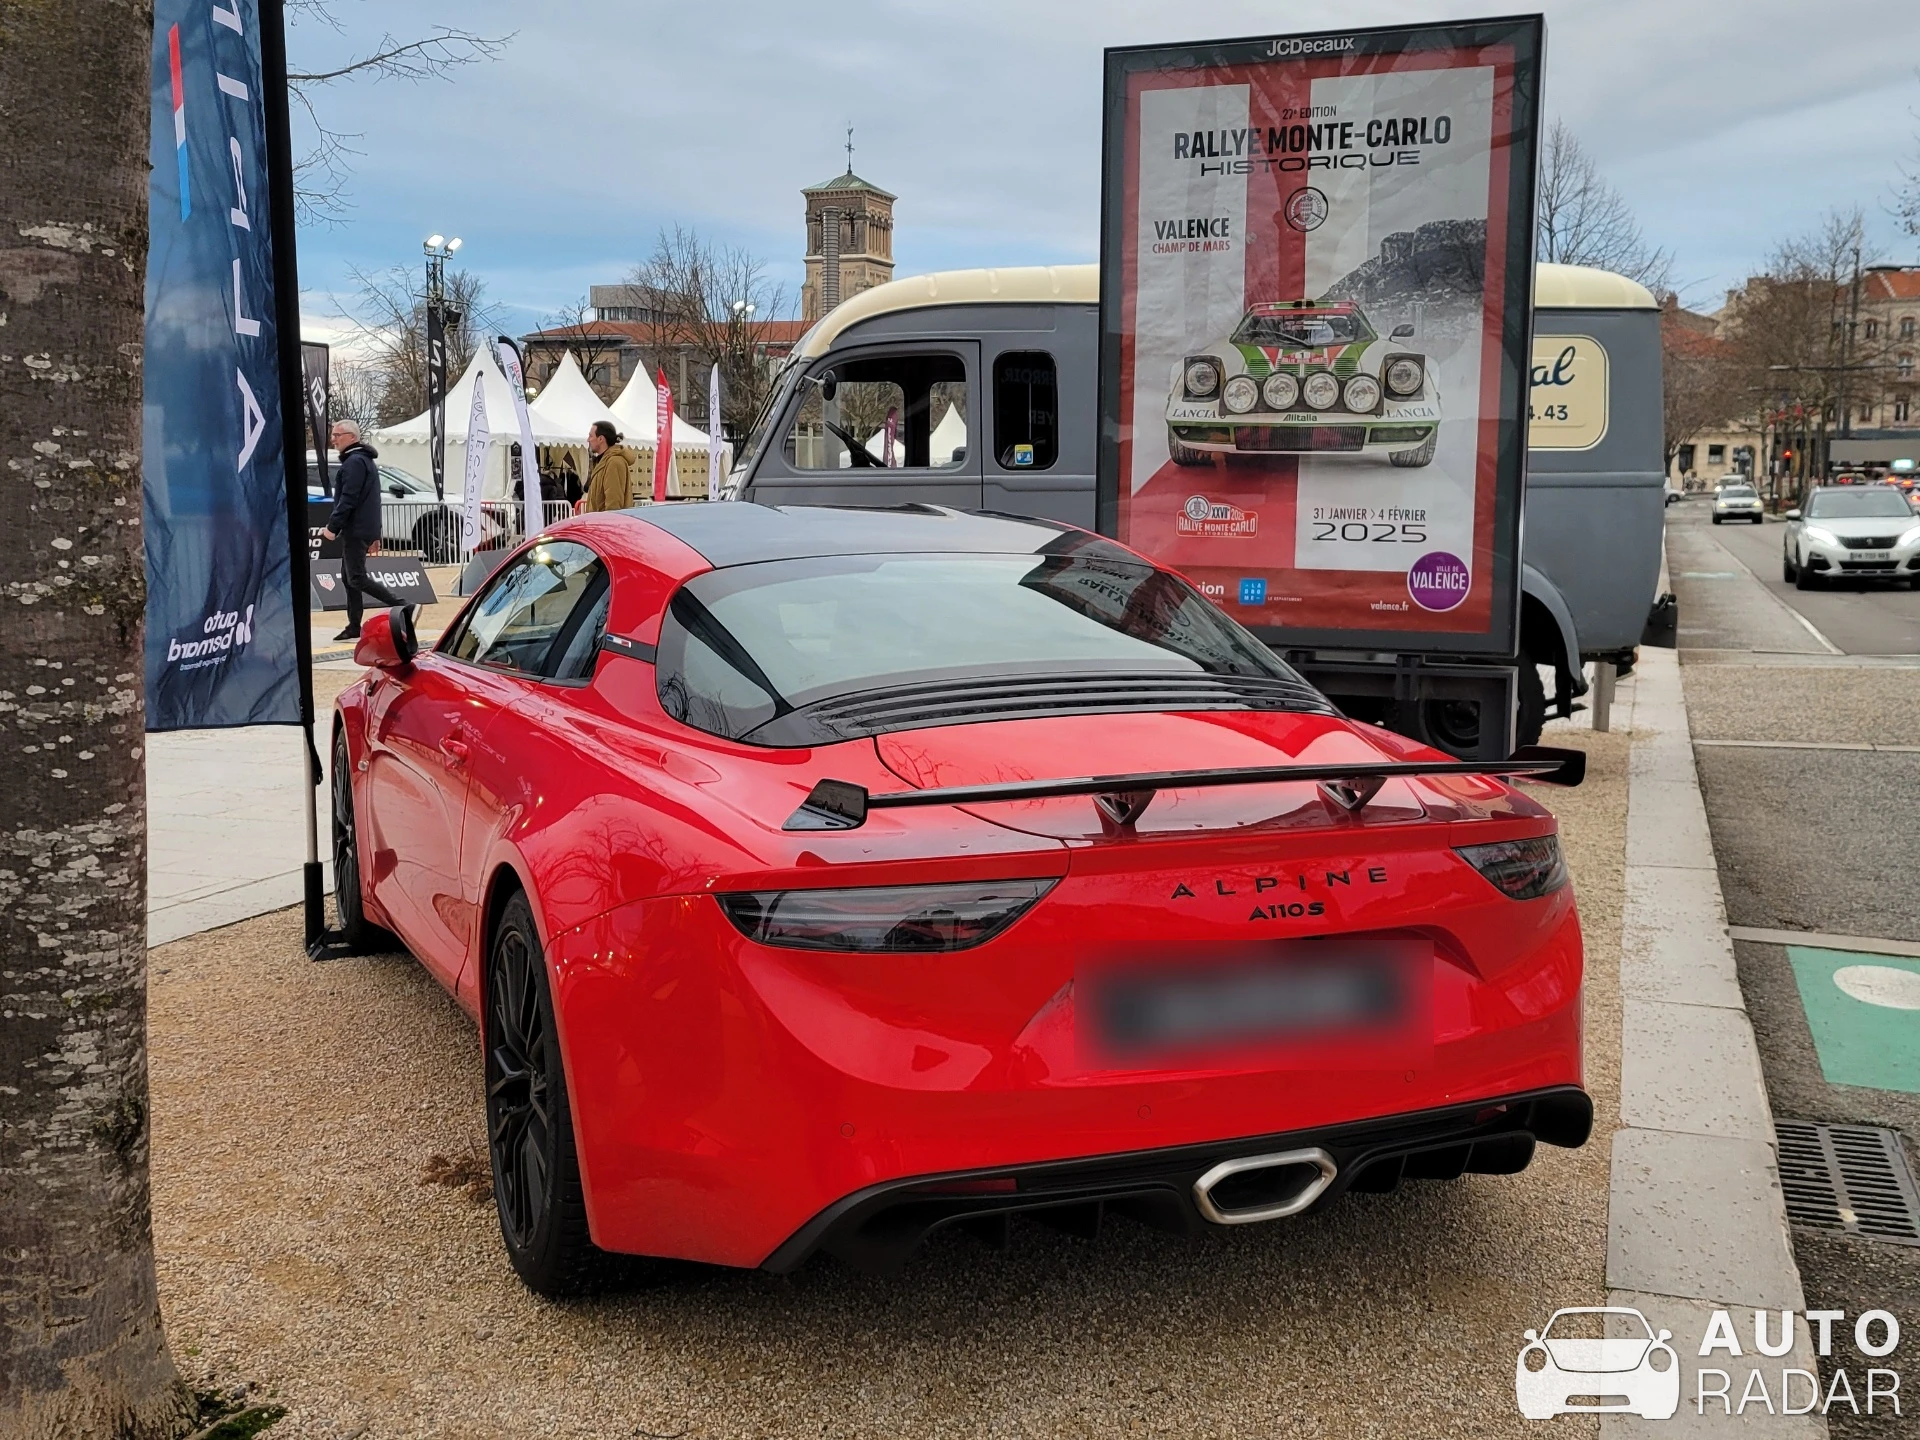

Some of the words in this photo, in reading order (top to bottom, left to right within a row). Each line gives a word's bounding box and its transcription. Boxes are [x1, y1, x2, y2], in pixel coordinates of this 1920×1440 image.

[1266, 37, 1355, 57] JCDecaux
[1299, 105, 1337, 119] EDITION
[1174, 127, 1262, 159] RALLYE
[1267, 115, 1452, 155] MONTE-CARLO
[1200, 150, 1421, 177] HISTORIQUE
[1153, 217, 1230, 241] VALENCE
[1152, 242, 1186, 255] CHAMP
[1188, 241, 1200, 253] DE
[1202, 240, 1231, 252] MARS
[1172, 408, 1217, 419] LANCIA
[1282, 413, 1319, 422] Alitalia
[1386, 407, 1436, 419] LANCIA
[1313, 507, 1325, 520] 31
[1327, 507, 1367, 520] JANVIER
[1378, 508, 1385, 521] 4
[1388, 505, 1427, 522] FÉVRIER
[1178, 515, 1203, 531] RALLYE
[1204, 517, 1257, 533] MONTE-CARLO
[1312, 522, 1428, 543] 2025
[1436, 565, 1451, 573] VILLE
[1452, 565, 1460, 573] DE
[371, 570, 420, 588] Heuer
[1412, 571, 1467, 590] VALENCE
[1196, 581, 1225, 595] ion
[1370, 600, 1410, 611] valence.fr
[1170, 867, 1389, 900] ALPINE
